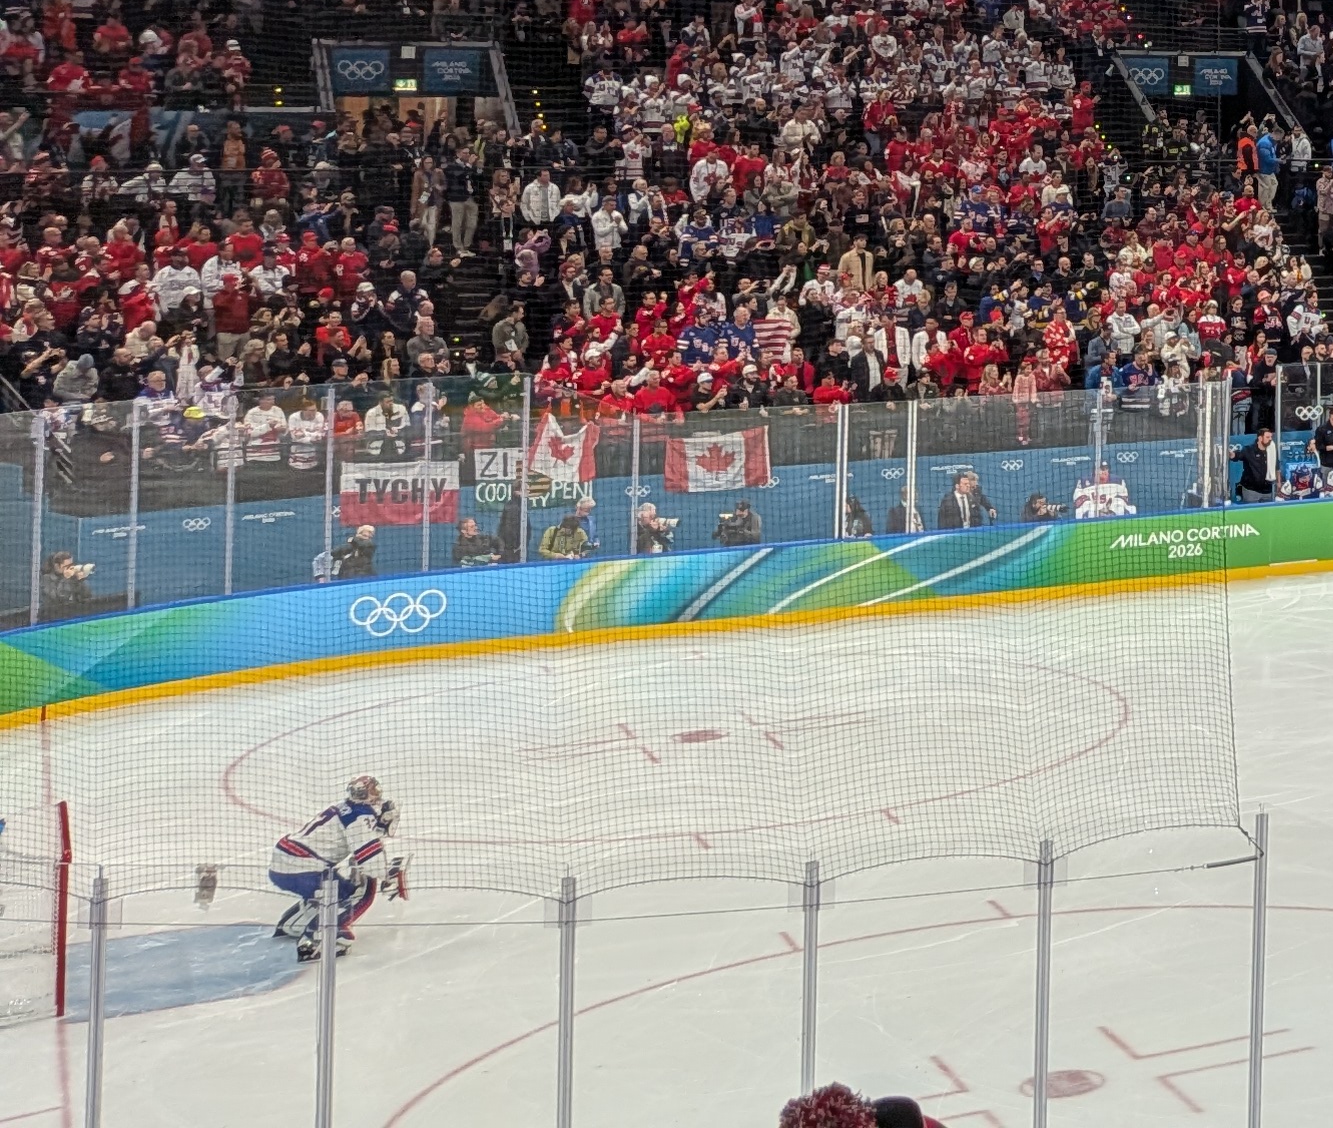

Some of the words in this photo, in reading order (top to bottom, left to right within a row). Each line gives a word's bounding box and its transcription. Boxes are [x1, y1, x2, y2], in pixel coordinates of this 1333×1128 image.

[355, 477, 447, 505] TYCHY
[1110, 530, 1183, 549] MILANO
[1186, 523, 1260, 543] CORTINA
[1167, 543, 1204, 559] 2026
